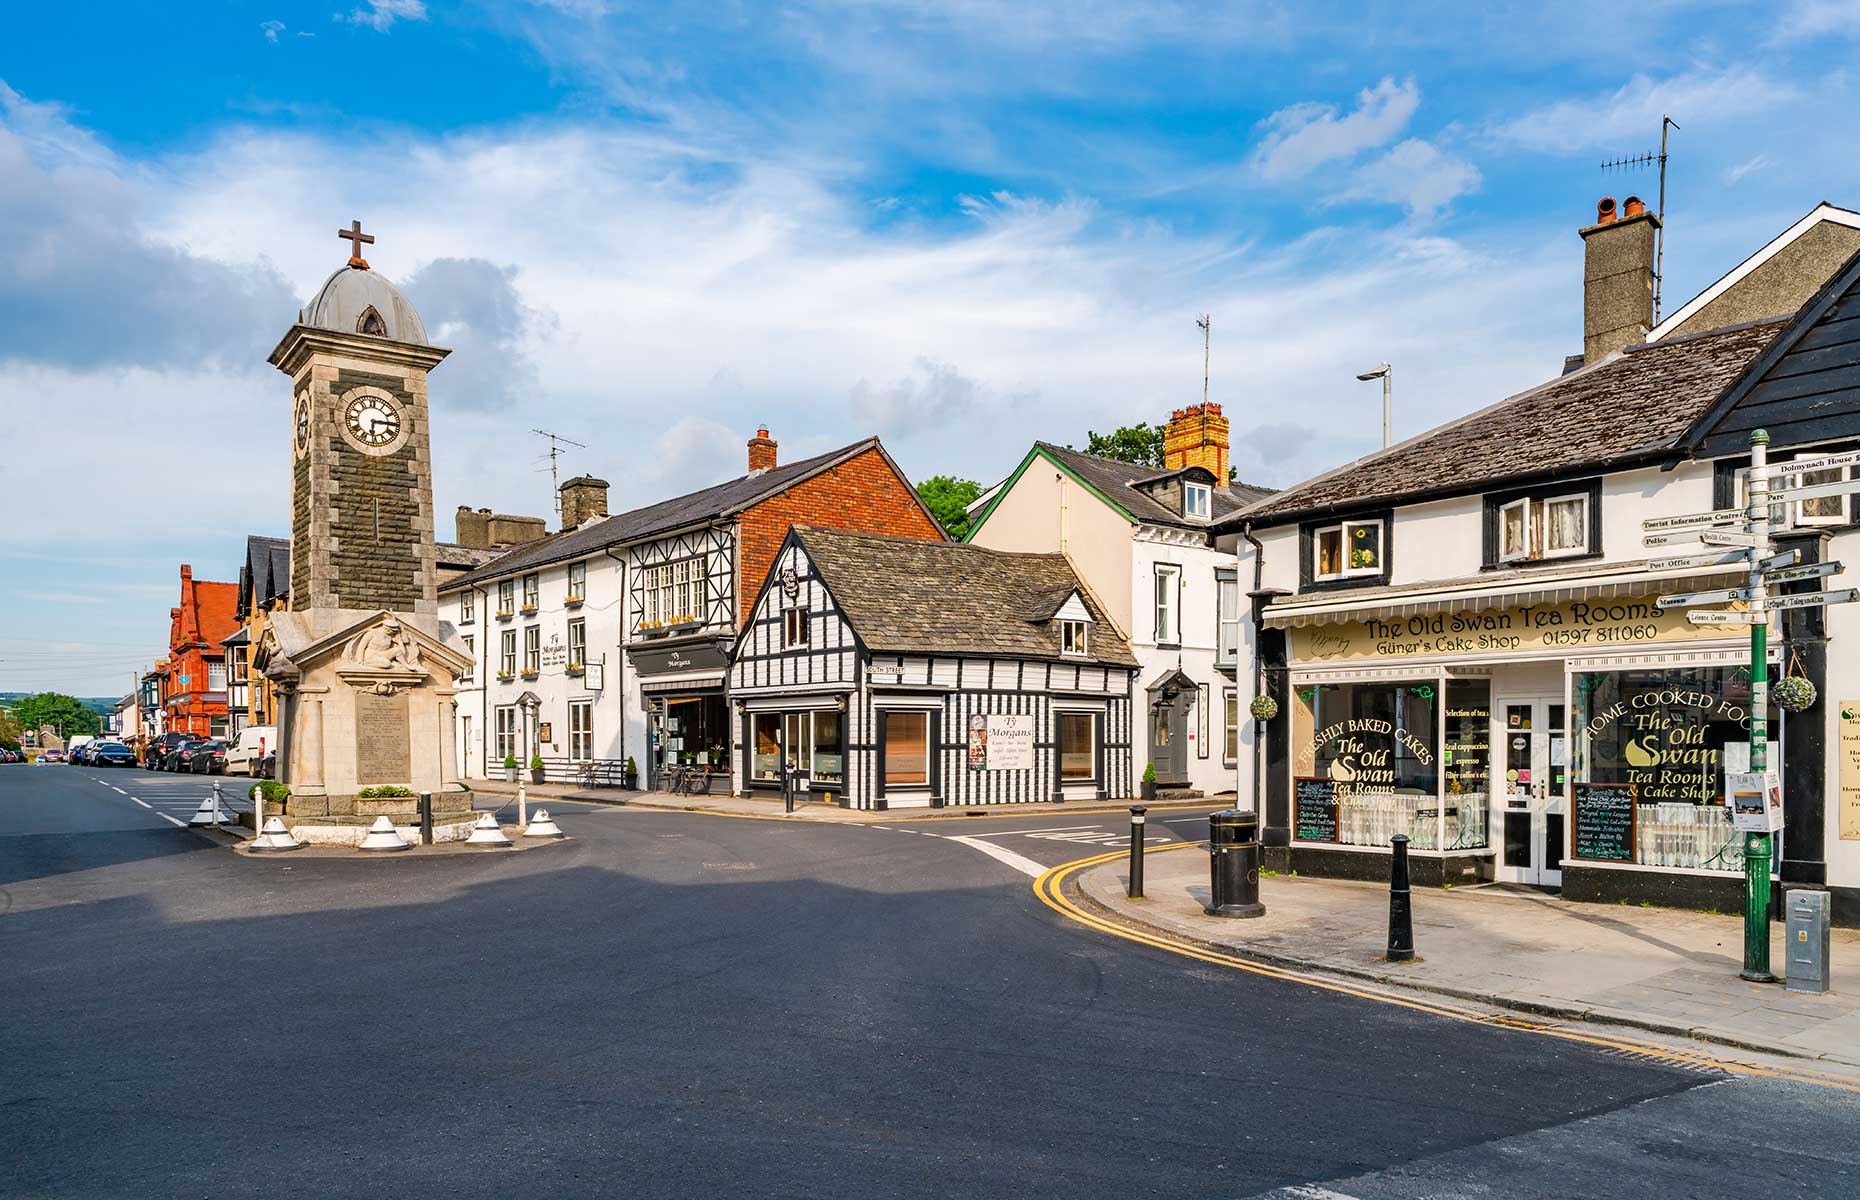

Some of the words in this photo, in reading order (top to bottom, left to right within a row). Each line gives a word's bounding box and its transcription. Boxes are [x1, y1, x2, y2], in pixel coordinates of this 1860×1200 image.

[1828, 456, 1853, 466] House
[1643, 519, 1669, 529] Tourist
[1671, 515, 1713, 526] Information
[1715, 512, 1739, 521] Centre
[1646, 536, 1667, 545] Police
[1650, 561, 1665, 570] Post
[1668, 558, 1691, 567] Office
[1659, 598, 1687, 606] Museum
[1364, 617, 1403, 640] The
[1408, 614, 1444, 635] Old
[1450, 611, 1512, 633] Swan
[1518, 606, 1563, 629] Tea
[1570, 601, 1665, 625] Rooms
[1691, 613, 1709, 621] Leisure
[1711, 613, 1727, 621] Centre
[1376, 639, 1431, 655] Güner's
[1434, 636, 1472, 652] Cake
[1477, 634, 1520, 650] Shop
[1542, 628, 1591, 646] 01597
[1596, 624, 1657, 642] 811060
[1445, 709, 1470, 717] Selection
[1471, 708, 1477, 716] of
[1583, 701, 1629, 741] HOME
[1631, 690, 1714, 709] COOKED
[1717, 700, 1751, 731] FOO
[1634, 710, 1671, 731] The
[989, 728, 1032, 739] Morgans
[1669, 724, 1710, 745] Old
[1298, 722, 1344, 764] FRESHLY
[1348, 718, 1392, 735] BAKED
[1394, 727, 1434, 766] CAKES
[1337, 736, 1364, 754] The
[1360, 749, 1390, 767] Old
[1625, 735, 1718, 767] Swan
[1331, 755, 1394, 783] Swan
[1456, 759, 1480, 767] espresso
[1445, 771, 1459, 779] filter
[1626, 769, 1653, 784] Tea
[1660, 769, 1716, 784] Rooms
[1331, 781, 1352, 795] Tea
[1355, 782, 1396, 795] Rooms
[1626, 784, 1640, 797] &
[1644, 785, 1676, 798] Cake
[1680, 785, 1716, 800] Shop
[1331, 795, 1341, 806] &
